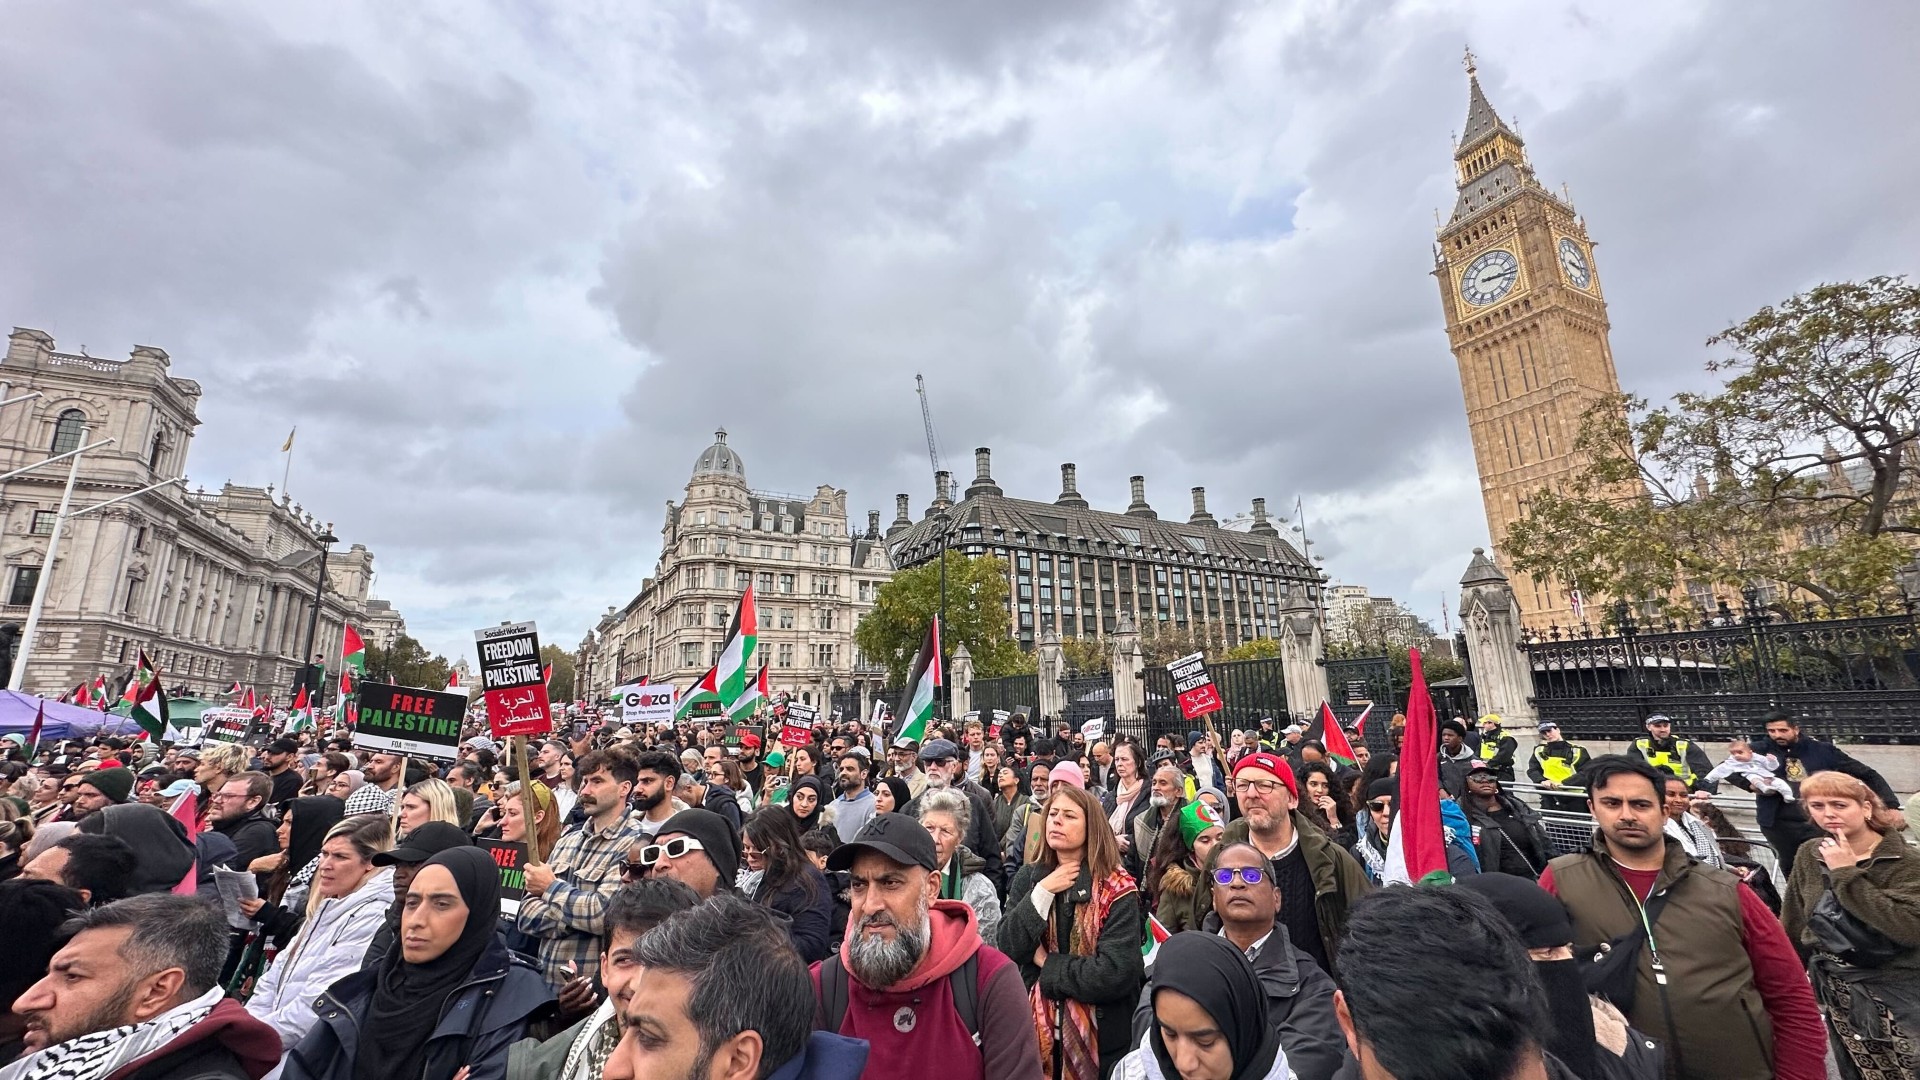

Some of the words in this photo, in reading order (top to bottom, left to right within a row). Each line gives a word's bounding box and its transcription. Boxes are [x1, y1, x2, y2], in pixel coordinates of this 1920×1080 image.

[483, 637, 534, 661] FREEDOM
[505, 659, 514, 667] for
[1172, 660, 1204, 680] FREEDOM
[485, 663, 541, 687] PALESTINE
[1175, 673, 1211, 694] PALESTINE
[390, 693, 436, 715] FREE
[498, 690, 535, 710] الحرية
[360, 707, 459, 737] PALESTINE
[498, 706, 544, 728] لفلسطين
[785, 717, 812, 730] PALESTINE
[789, 707, 813, 719] FREEDOM
[391, 740, 402, 749] FOA
[490, 847, 518, 868] FREE
